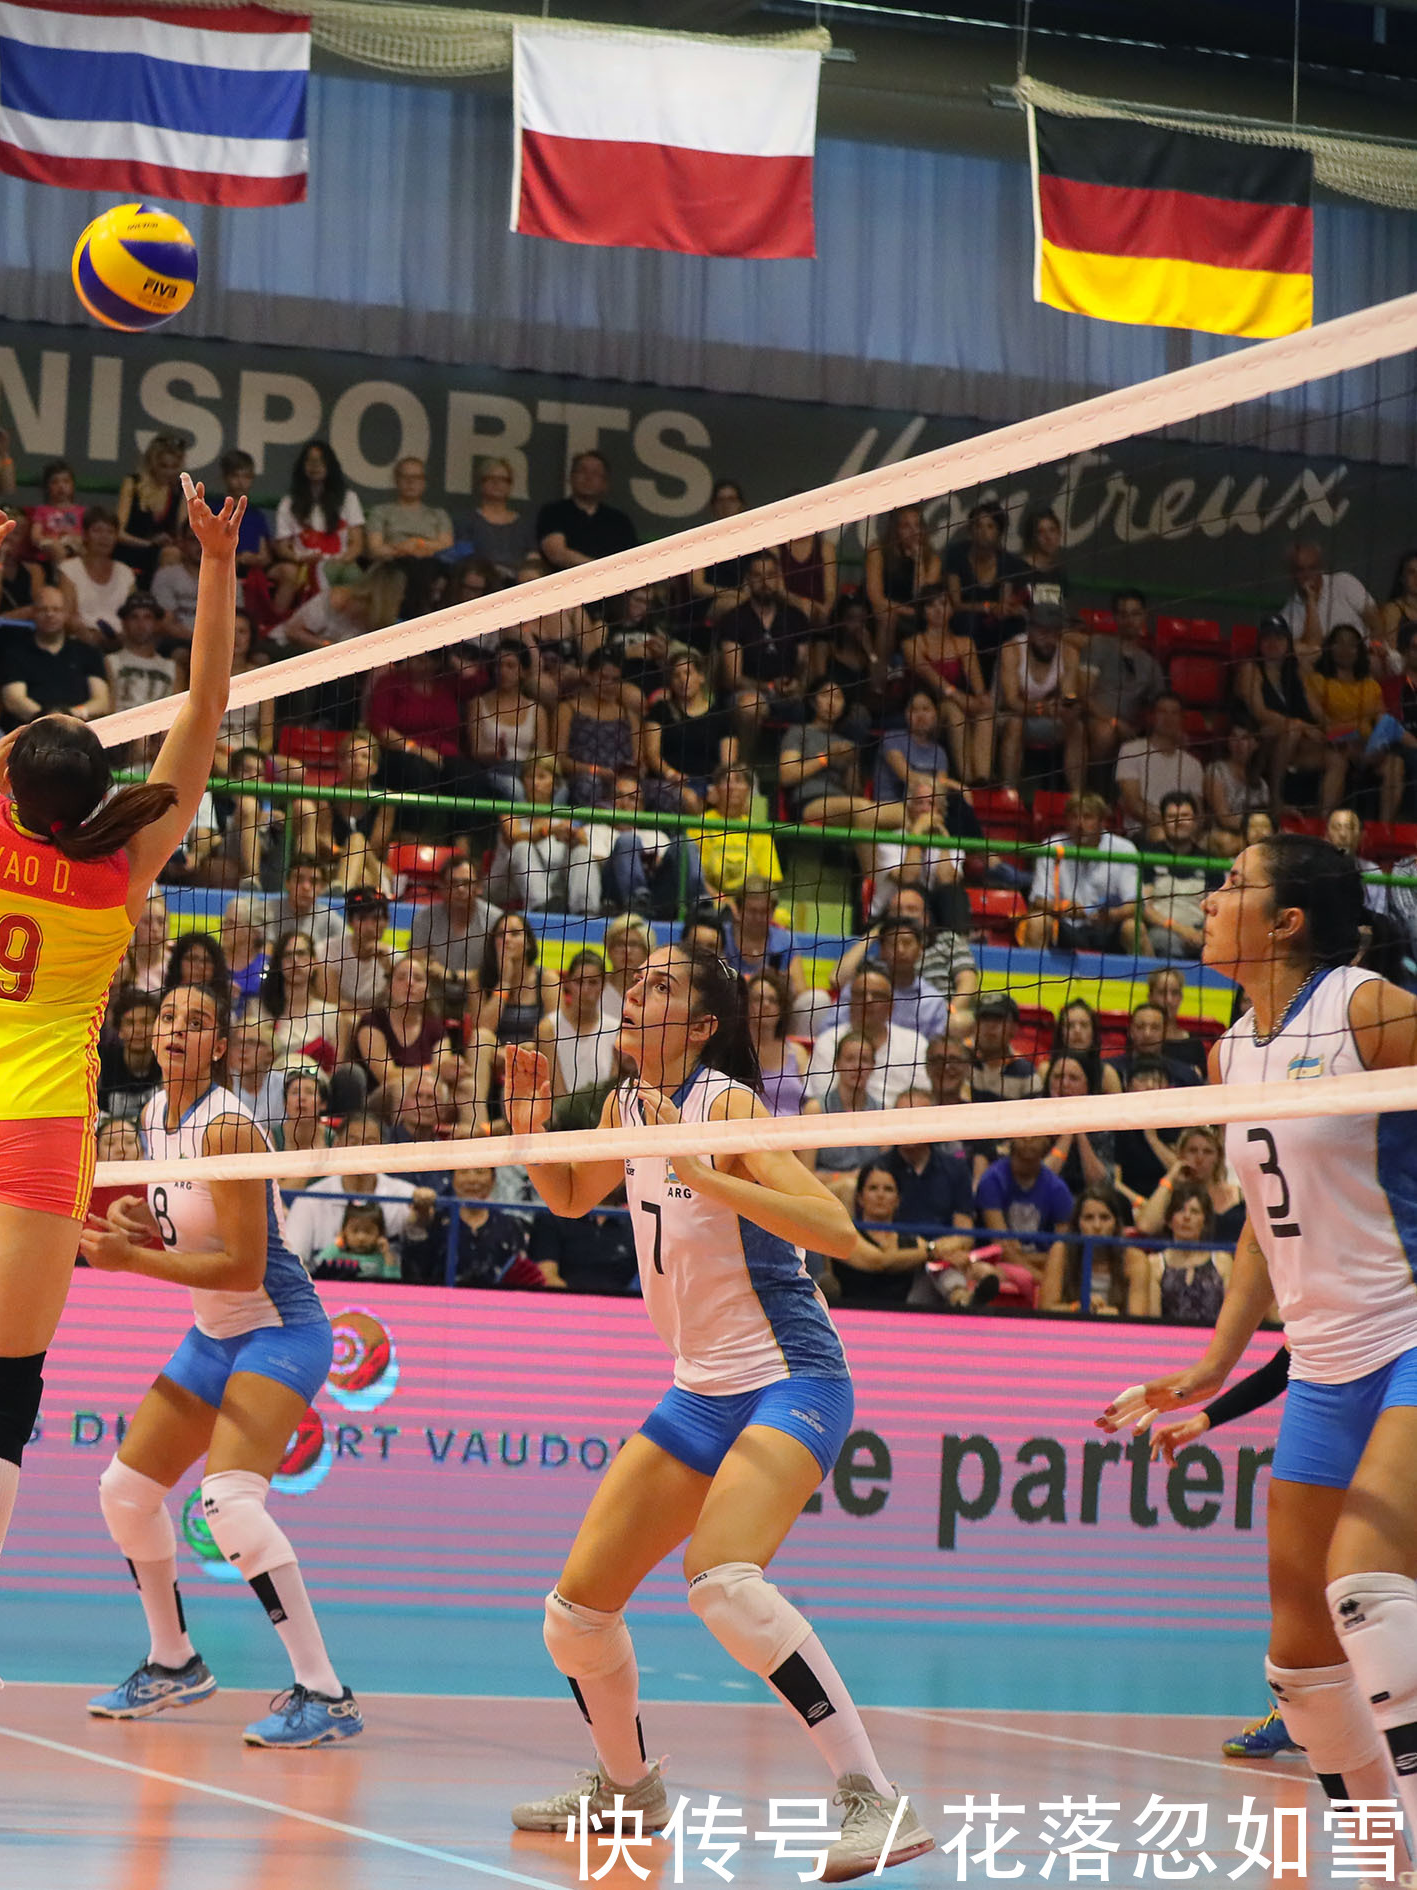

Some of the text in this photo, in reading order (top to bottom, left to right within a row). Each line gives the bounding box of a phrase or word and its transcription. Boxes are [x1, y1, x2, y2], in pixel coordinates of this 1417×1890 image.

[53, 859, 76, 896] D.
[667, 1186, 693, 1200] ARG
[1247, 1127, 1291, 1219] 3
[153, 1186, 177, 1247] 8
[641, 1200, 665, 1275] 7
[424, 1427, 626, 1472] VAUDO
